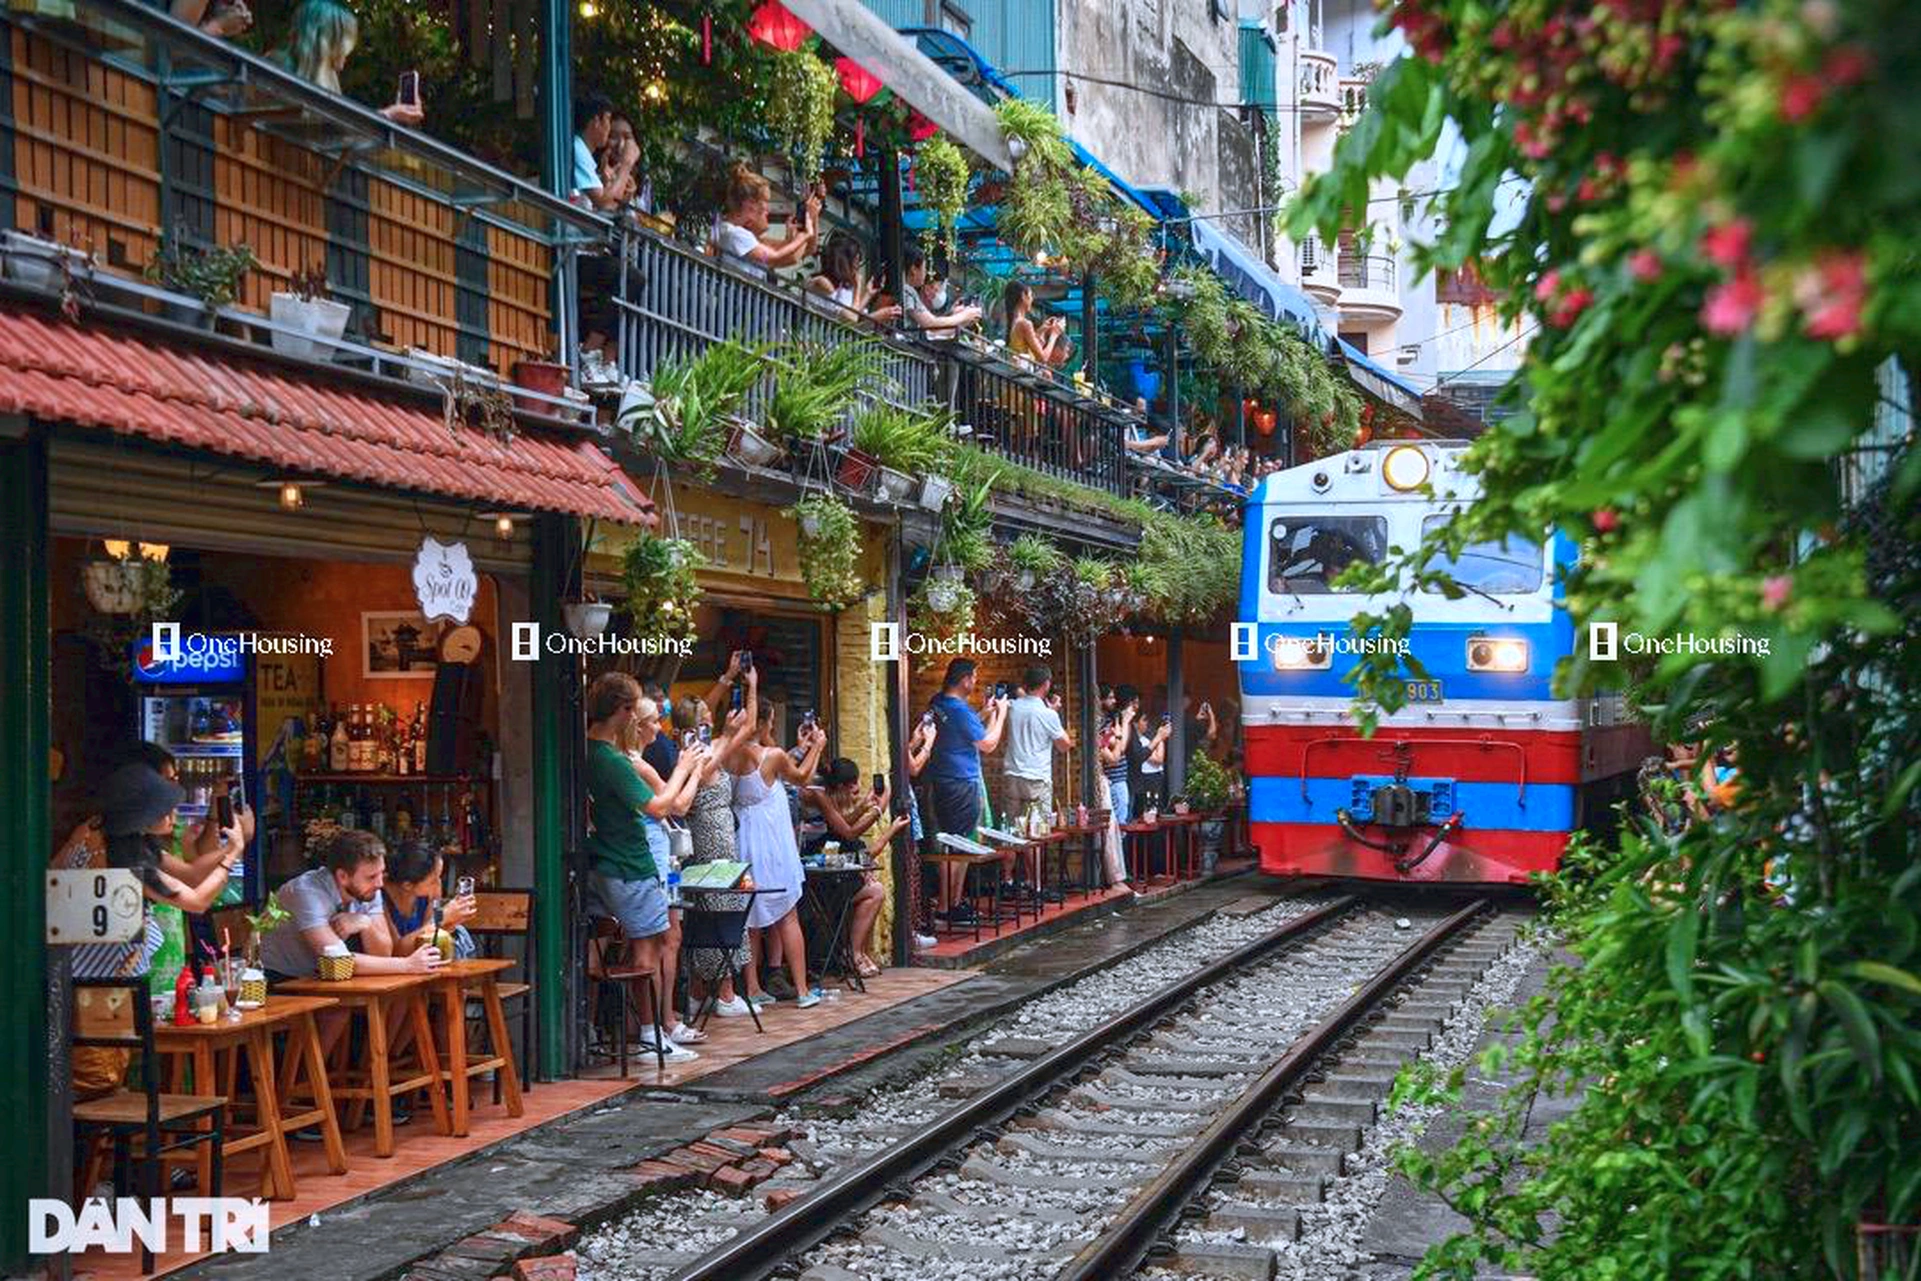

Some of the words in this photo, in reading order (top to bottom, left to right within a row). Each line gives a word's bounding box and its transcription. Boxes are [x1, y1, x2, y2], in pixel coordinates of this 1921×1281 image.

[740, 512, 775, 577] 74
[172, 648, 239, 672] pepsi
[260, 663, 298, 692] TEA
